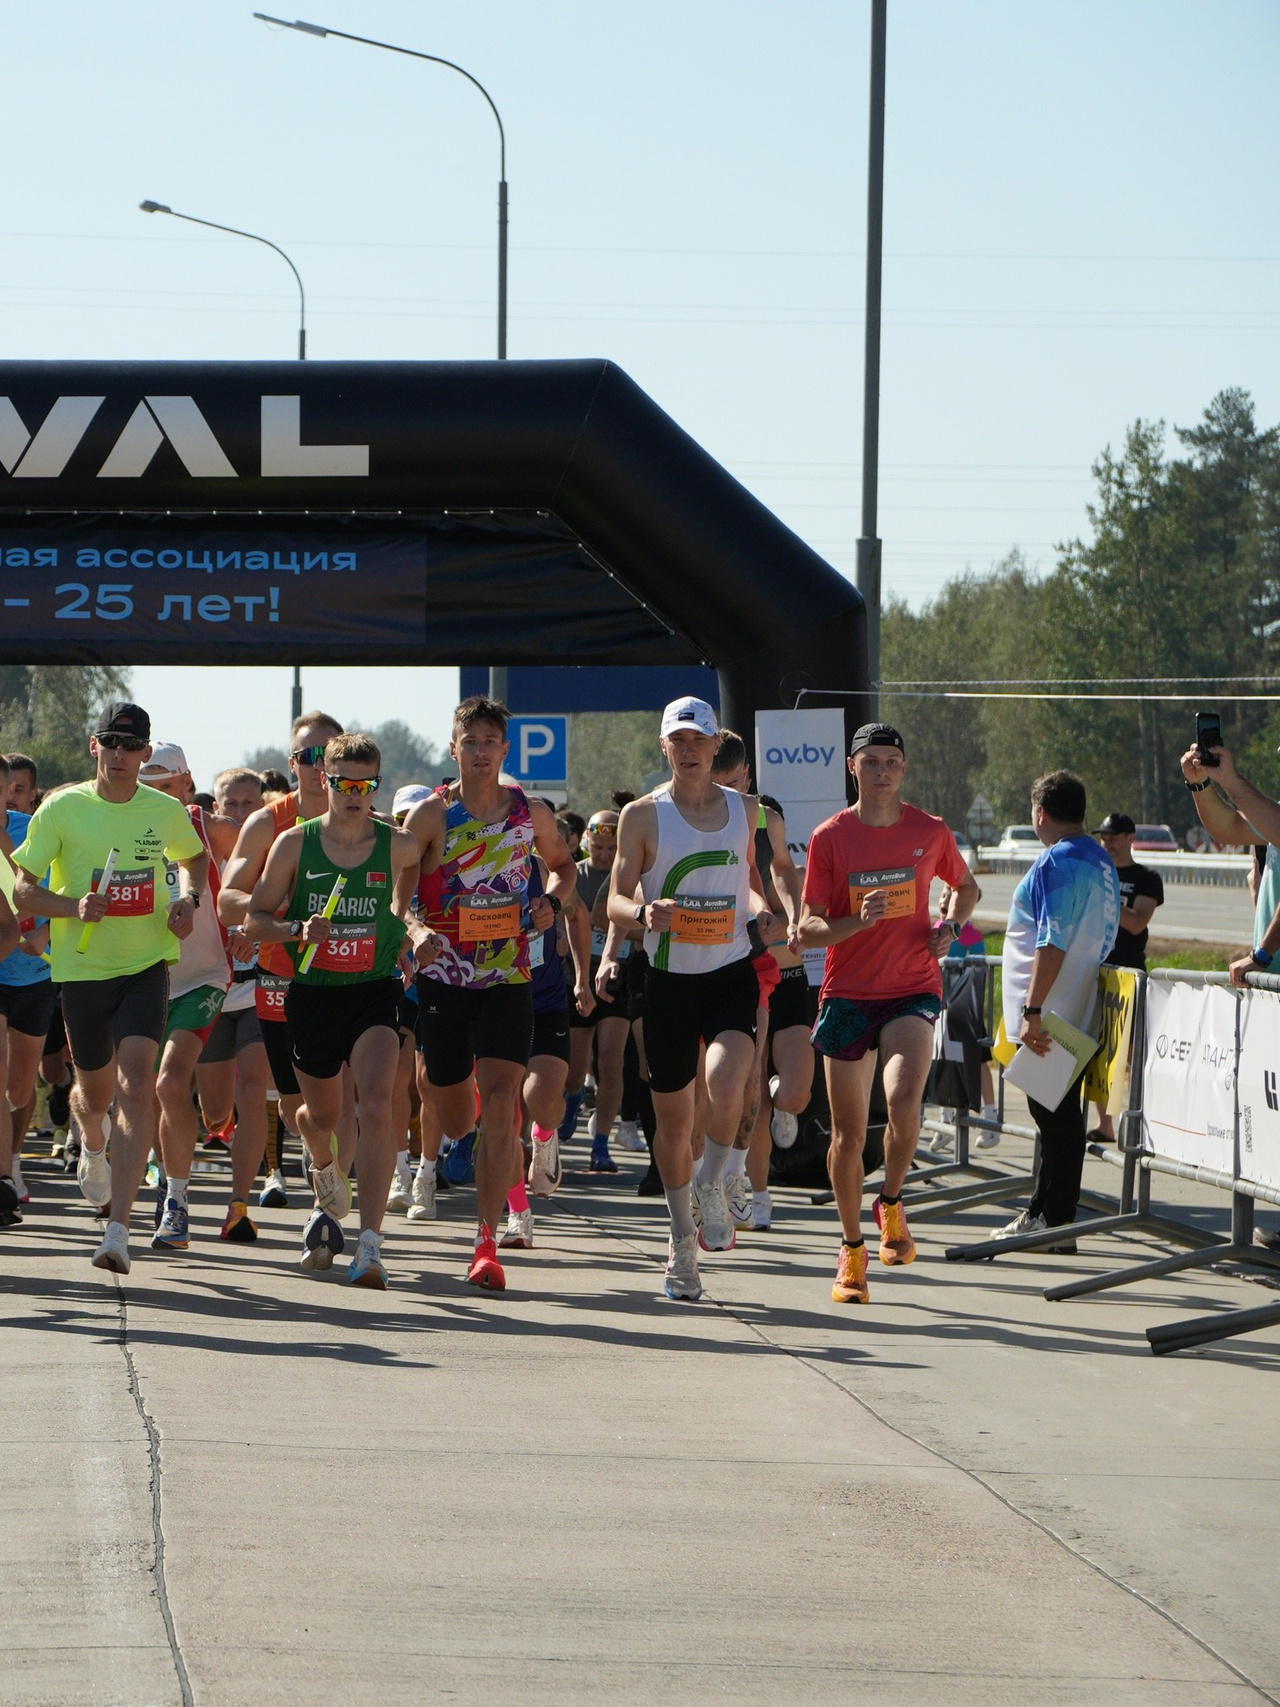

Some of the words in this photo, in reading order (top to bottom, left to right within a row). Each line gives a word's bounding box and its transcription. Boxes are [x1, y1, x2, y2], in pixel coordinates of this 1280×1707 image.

[75, 547, 357, 575] ассоциация
[54, 582, 135, 620] 25
[157, 586, 281, 622] лет!
[766, 743, 836, 766] av.by
[110, 885, 141, 901] 381
[308, 892, 378, 917] BEARUS
[469, 912, 512, 922] Сасковец
[680, 913, 728, 925] Пригожий
[326, 940, 358, 956] 361
[265, 991, 285, 1006] 35
